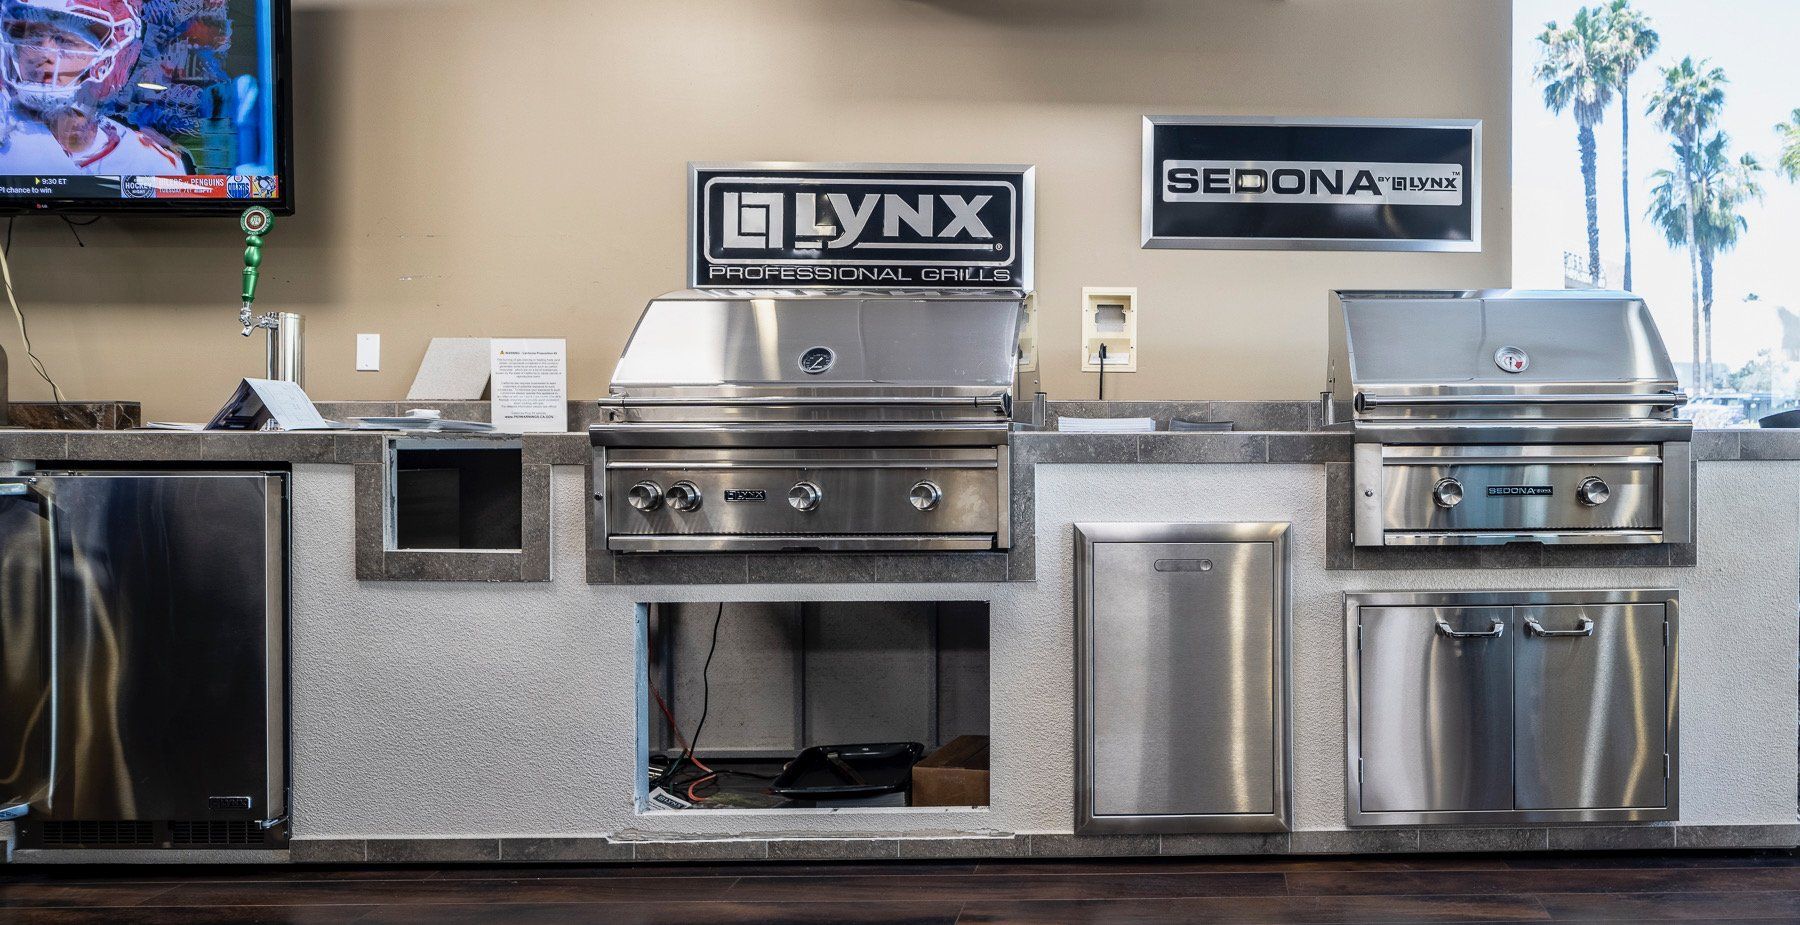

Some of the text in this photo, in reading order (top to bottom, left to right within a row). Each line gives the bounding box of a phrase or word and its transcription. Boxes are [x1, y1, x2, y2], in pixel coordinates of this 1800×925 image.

[190, 178, 225, 187] PENGUINS
[1167, 167, 1383, 195] SEDONA
[1409, 176, 1458, 192] LYNX
[6, 186, 31, 194] chance
[31, 186, 39, 194] to
[39, 186, 52, 194] win
[794, 192, 994, 249] LYNX
[709, 265, 1011, 282] PROFESSIONAL GRILLS
[1488, 487, 1536, 495] SEDONA
